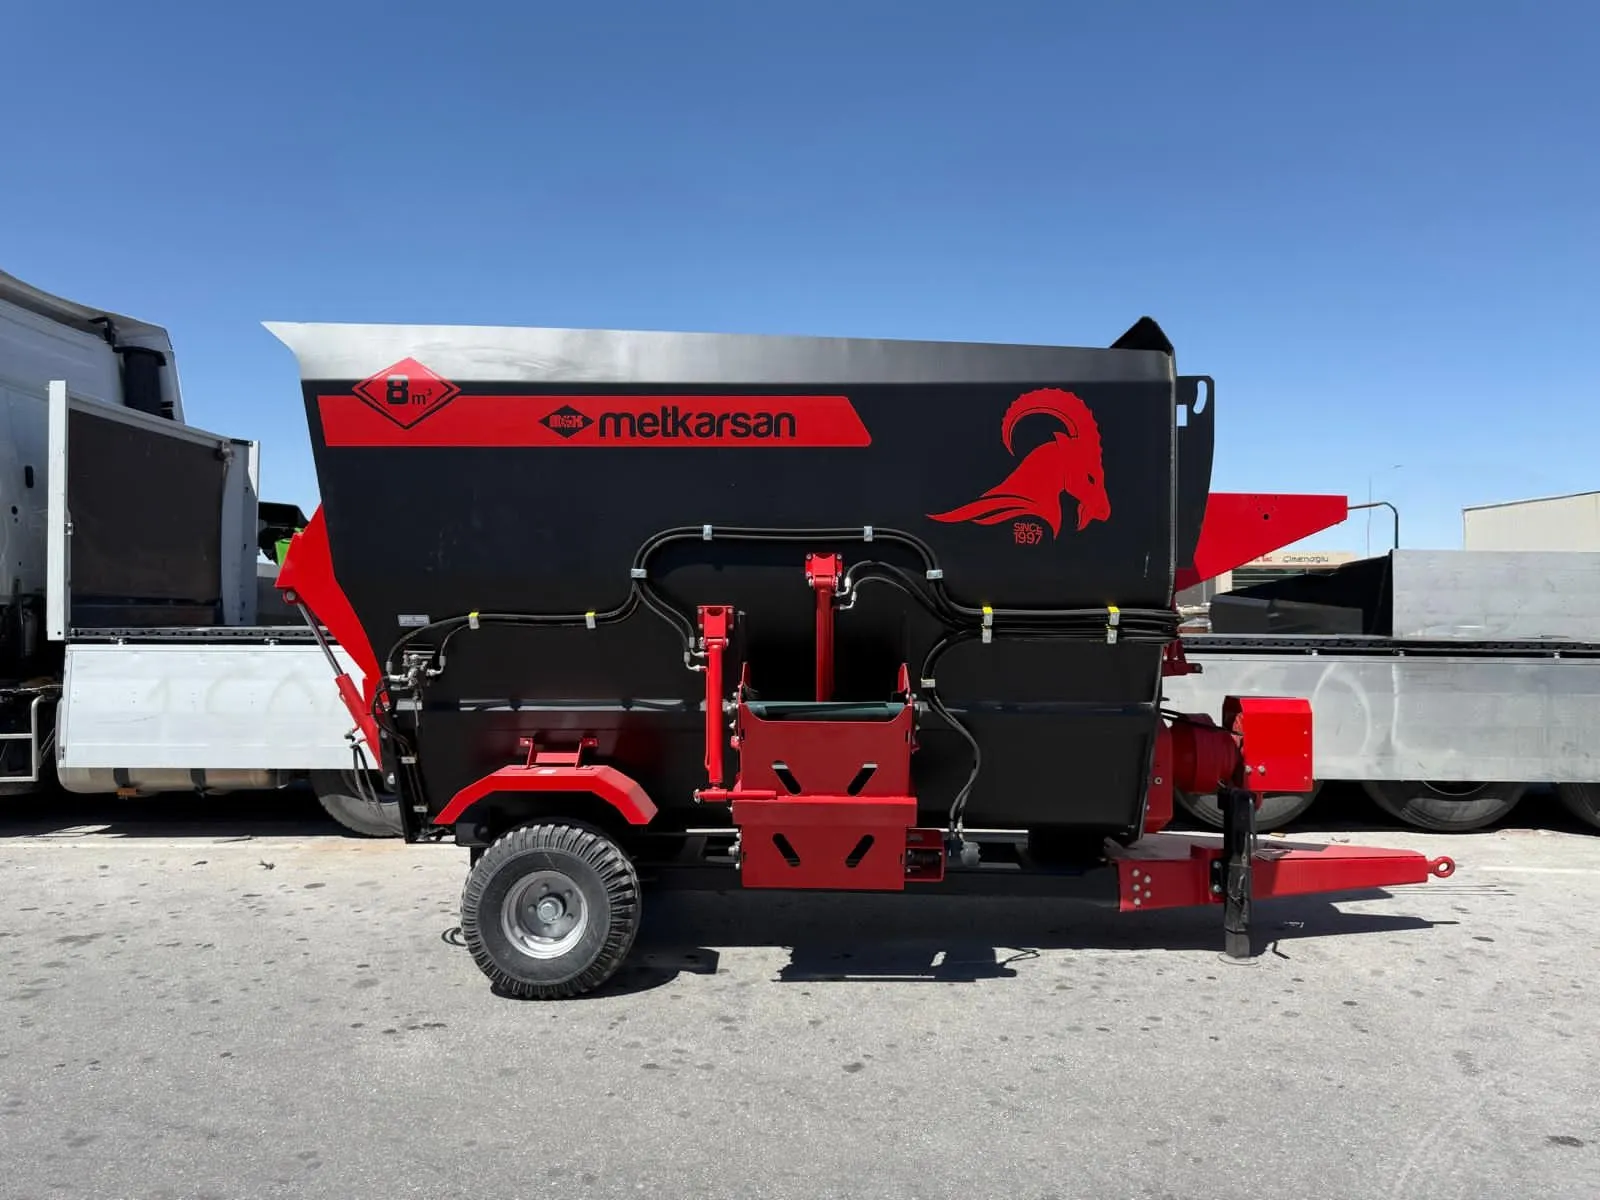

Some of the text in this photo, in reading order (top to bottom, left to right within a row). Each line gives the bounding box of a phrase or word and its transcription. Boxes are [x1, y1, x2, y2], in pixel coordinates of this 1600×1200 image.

[386, 375, 409, 405] 8
[599, 405, 796, 438] metkarsan
[1013, 522, 1043, 532] SINCE
[1014, 531, 1043, 545] 1997
